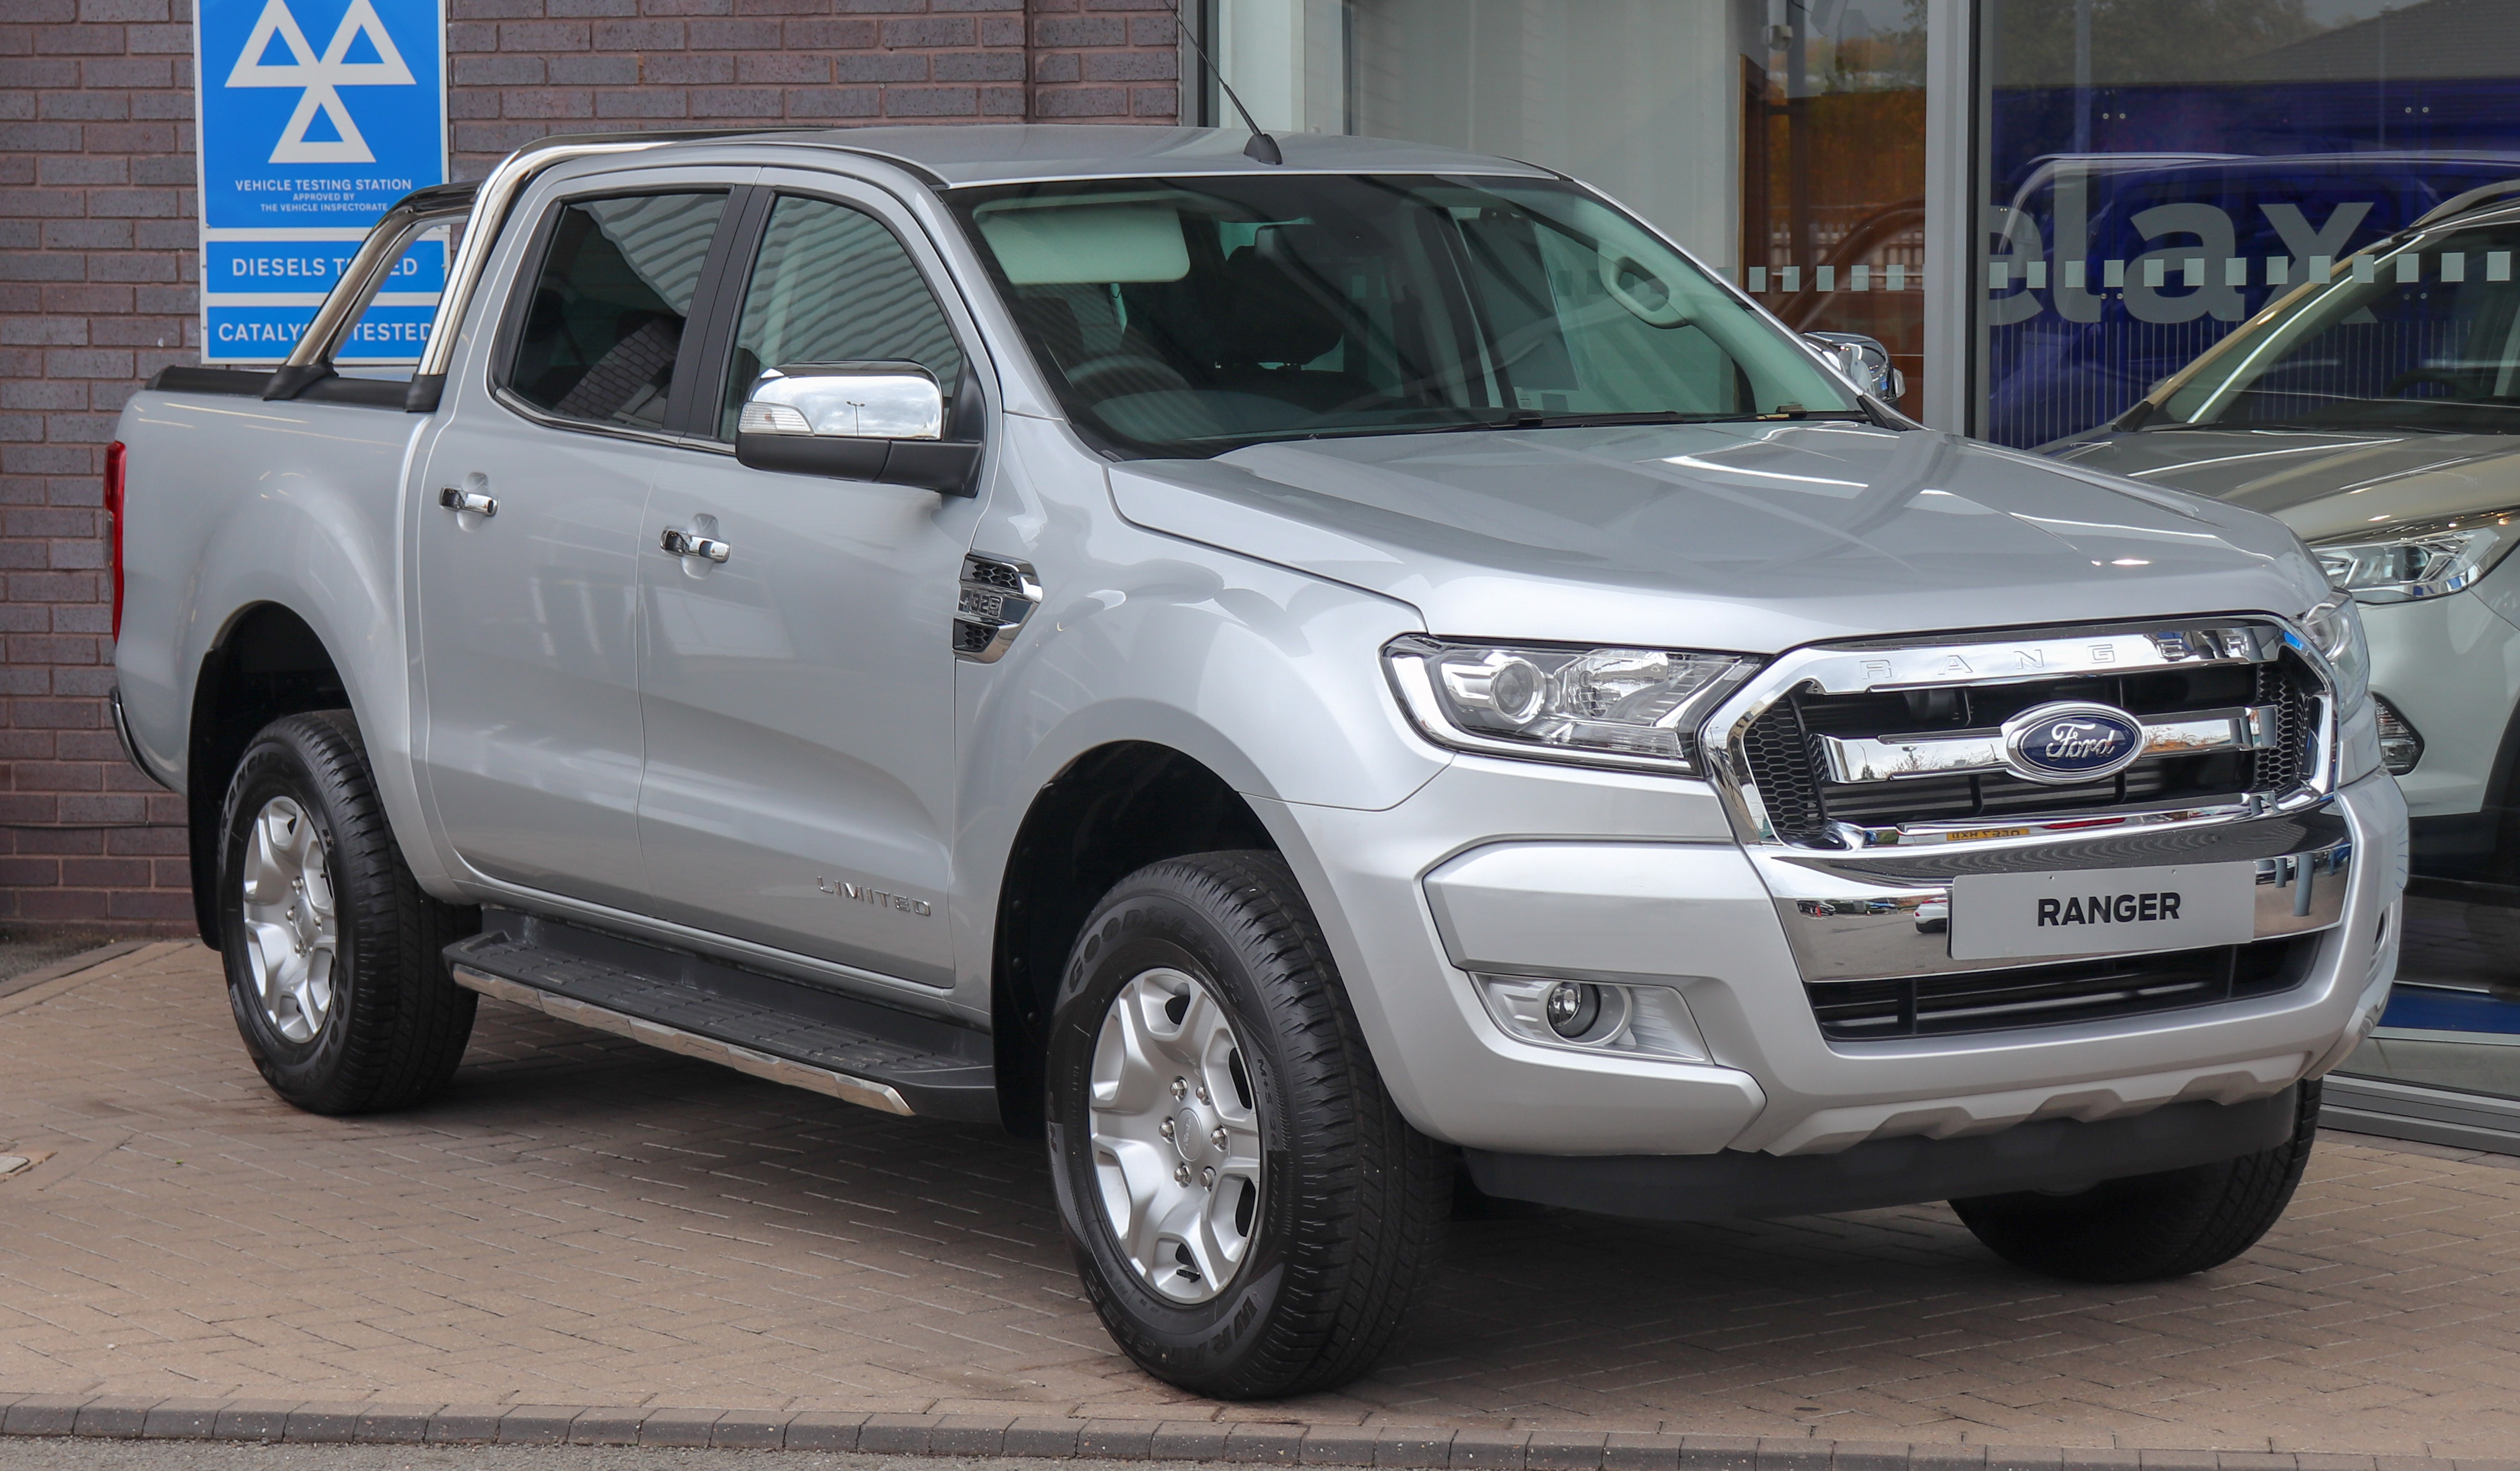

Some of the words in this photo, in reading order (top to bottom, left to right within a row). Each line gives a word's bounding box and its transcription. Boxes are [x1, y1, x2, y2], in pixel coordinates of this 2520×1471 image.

[236, 180, 292, 191] VEHICLE
[295, 179, 351, 191] TESTING
[356, 178, 412, 190] STATION
[293, 193, 341, 201] APPROVED
[321, 203, 387, 211] INSPECTORATE
[232, 258, 326, 277] DIESELS
[218, 323, 309, 341] CATALY
[1860, 633, 2250, 680] RANGER
[2045, 723, 2115, 760] Ford
[817, 876, 931, 917] LIMITED
[2037, 891, 2180, 927] RANGER
[1069, 906, 1245, 1004] GOODYEAR
